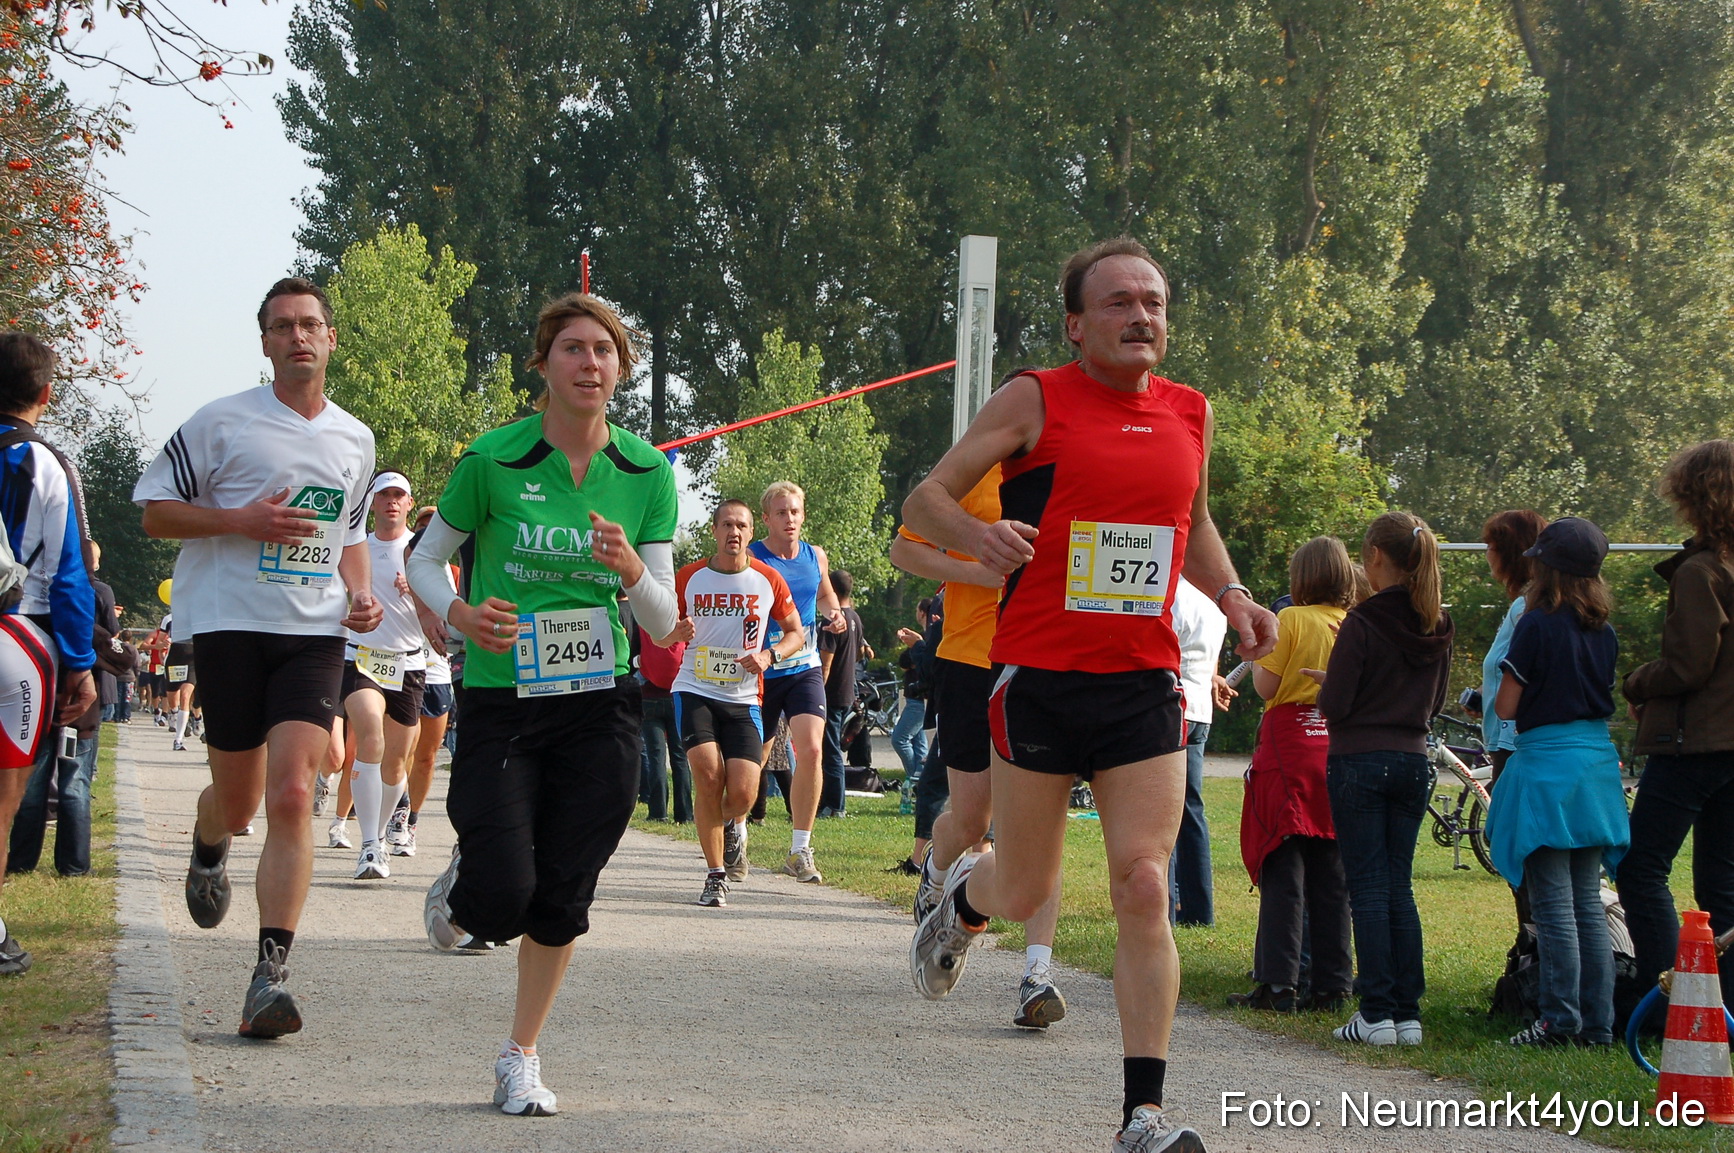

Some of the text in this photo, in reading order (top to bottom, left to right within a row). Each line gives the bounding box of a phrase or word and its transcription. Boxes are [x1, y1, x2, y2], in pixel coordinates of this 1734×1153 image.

[1131, 425, 1153, 433] asics
[297, 490, 343, 511] AOK
[520, 492, 546, 502] erima
[1101, 529, 1152, 549] Michael
[286, 545, 331, 565] 2282
[1073, 555, 1081, 568] C
[1110, 559, 1159, 586] 572
[694, 593, 759, 609] MERZ
[541, 619, 590, 635] Theresa
[520, 645, 528, 657] B
[545, 638, 605, 666] 2494
[372, 662, 397, 677] 289
[712, 662, 738, 675] 473
